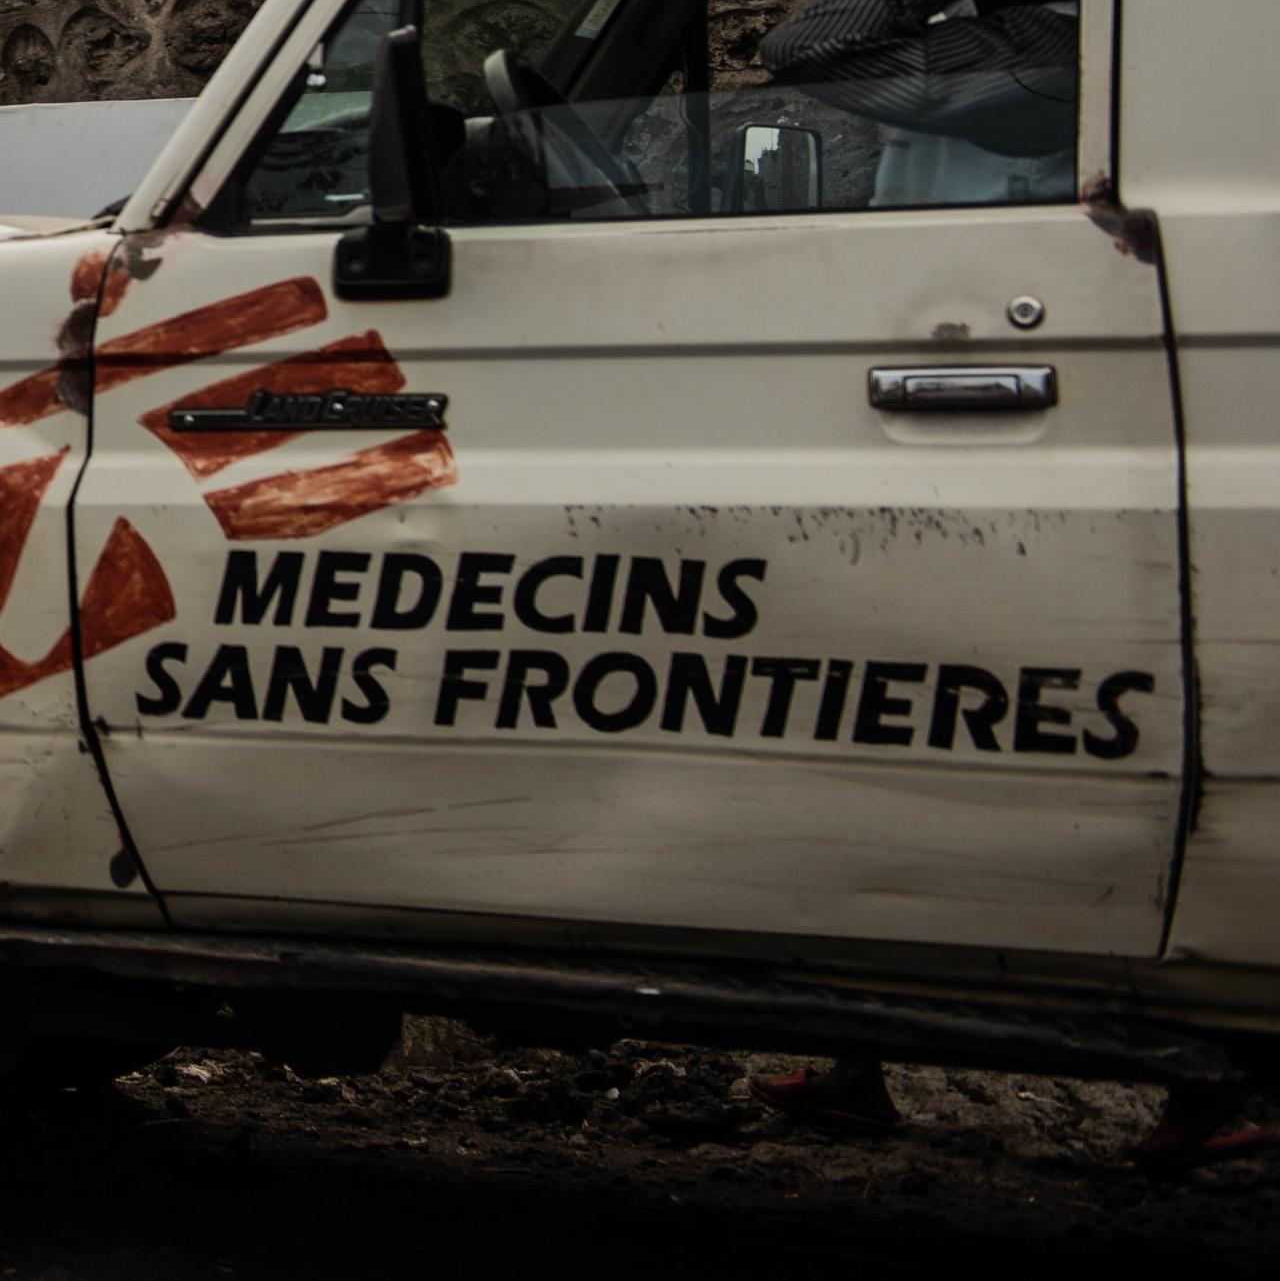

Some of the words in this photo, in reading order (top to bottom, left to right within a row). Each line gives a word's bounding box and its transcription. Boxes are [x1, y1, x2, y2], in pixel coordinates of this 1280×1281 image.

[214, 550, 768, 638] MEDECINS
[135, 643, 396, 725] SANS
[433, 648, 1155, 761] FRONTIERES
